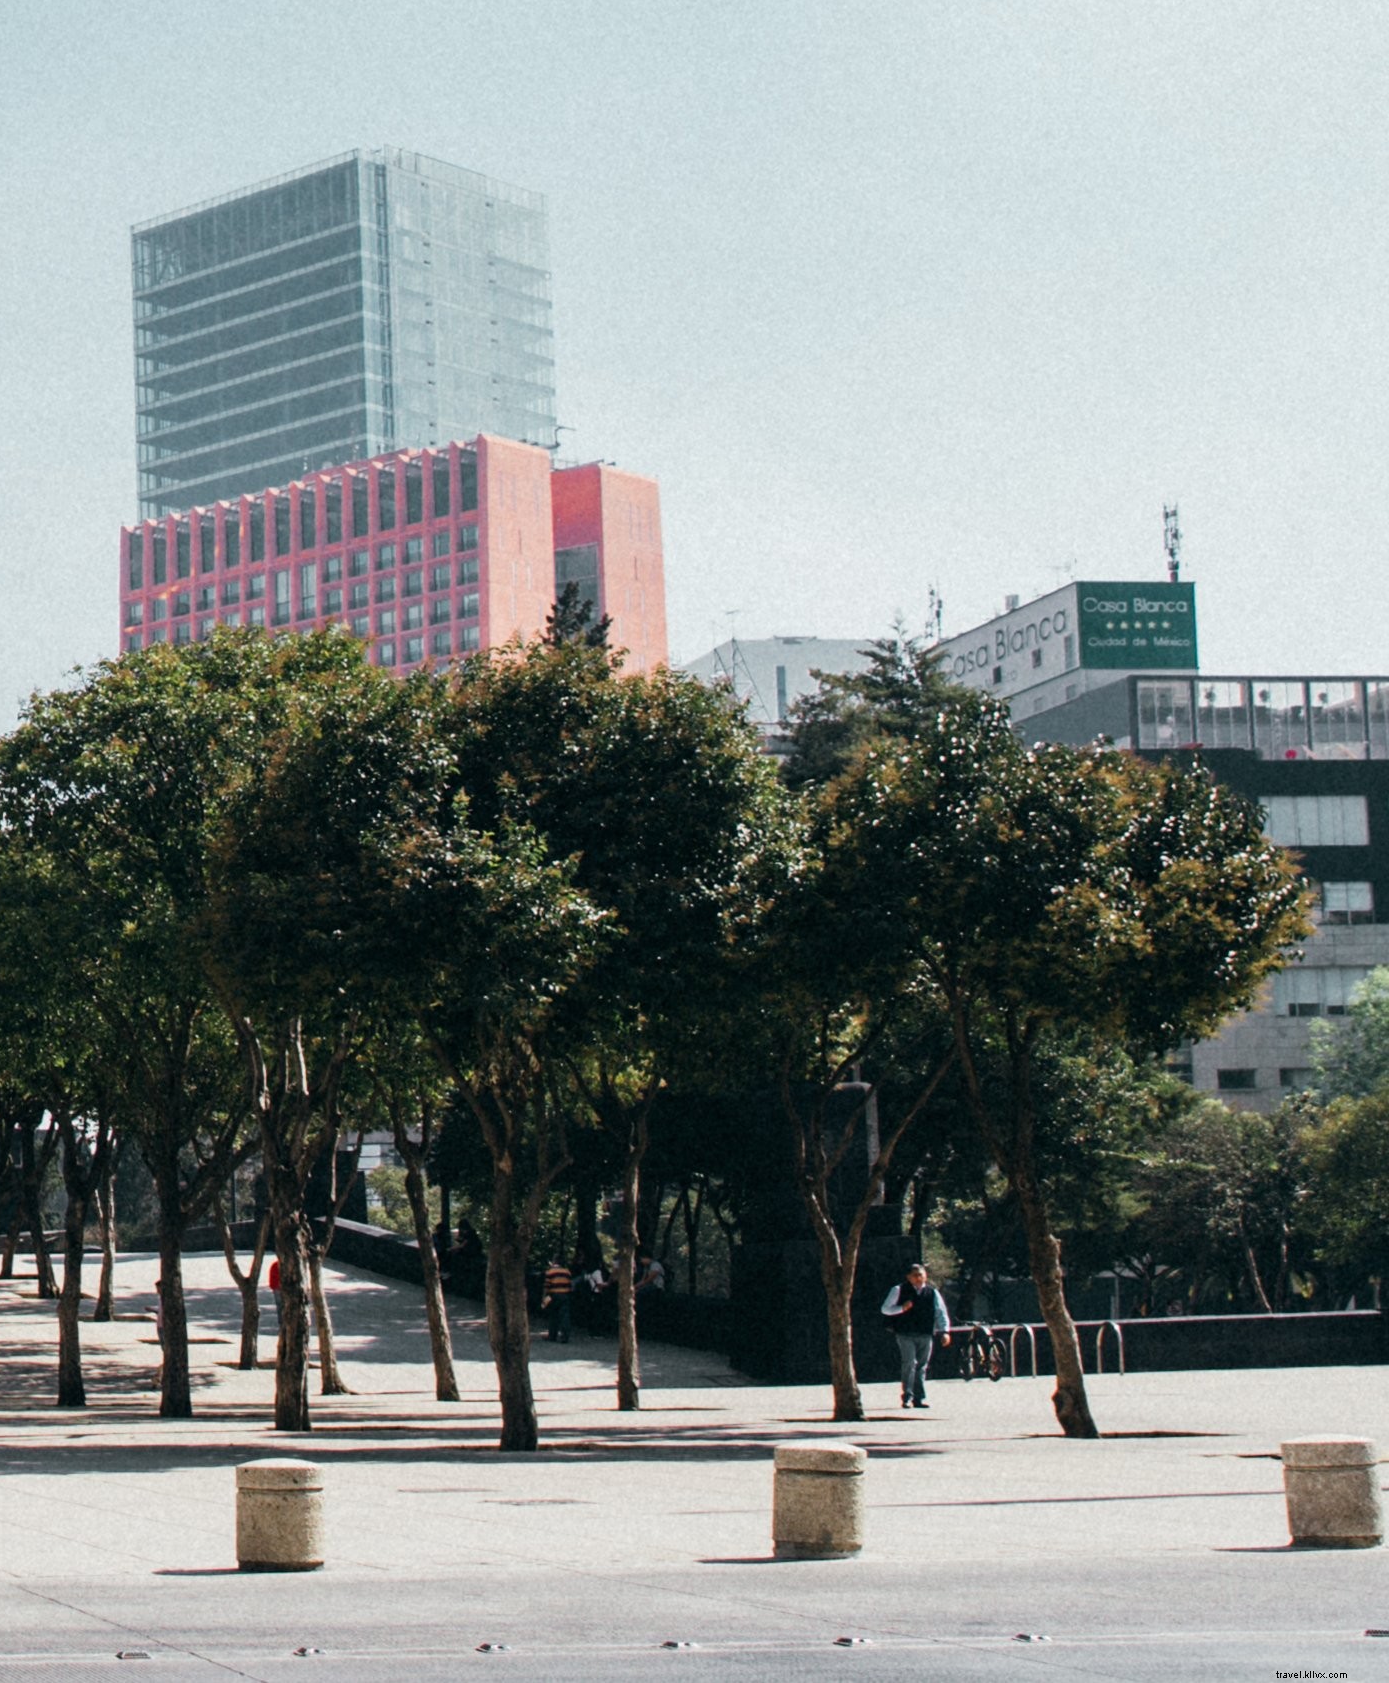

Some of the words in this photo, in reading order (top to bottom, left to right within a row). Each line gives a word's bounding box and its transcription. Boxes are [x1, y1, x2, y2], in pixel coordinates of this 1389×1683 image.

[1082, 597, 1128, 613] Casa
[1133, 597, 1188, 613] Blanca
[994, 608, 1067, 662] Blanca
[1087, 637, 1127, 646] Ciudad
[1132, 637, 1147, 646] de
[1153, 636, 1190, 646] México
